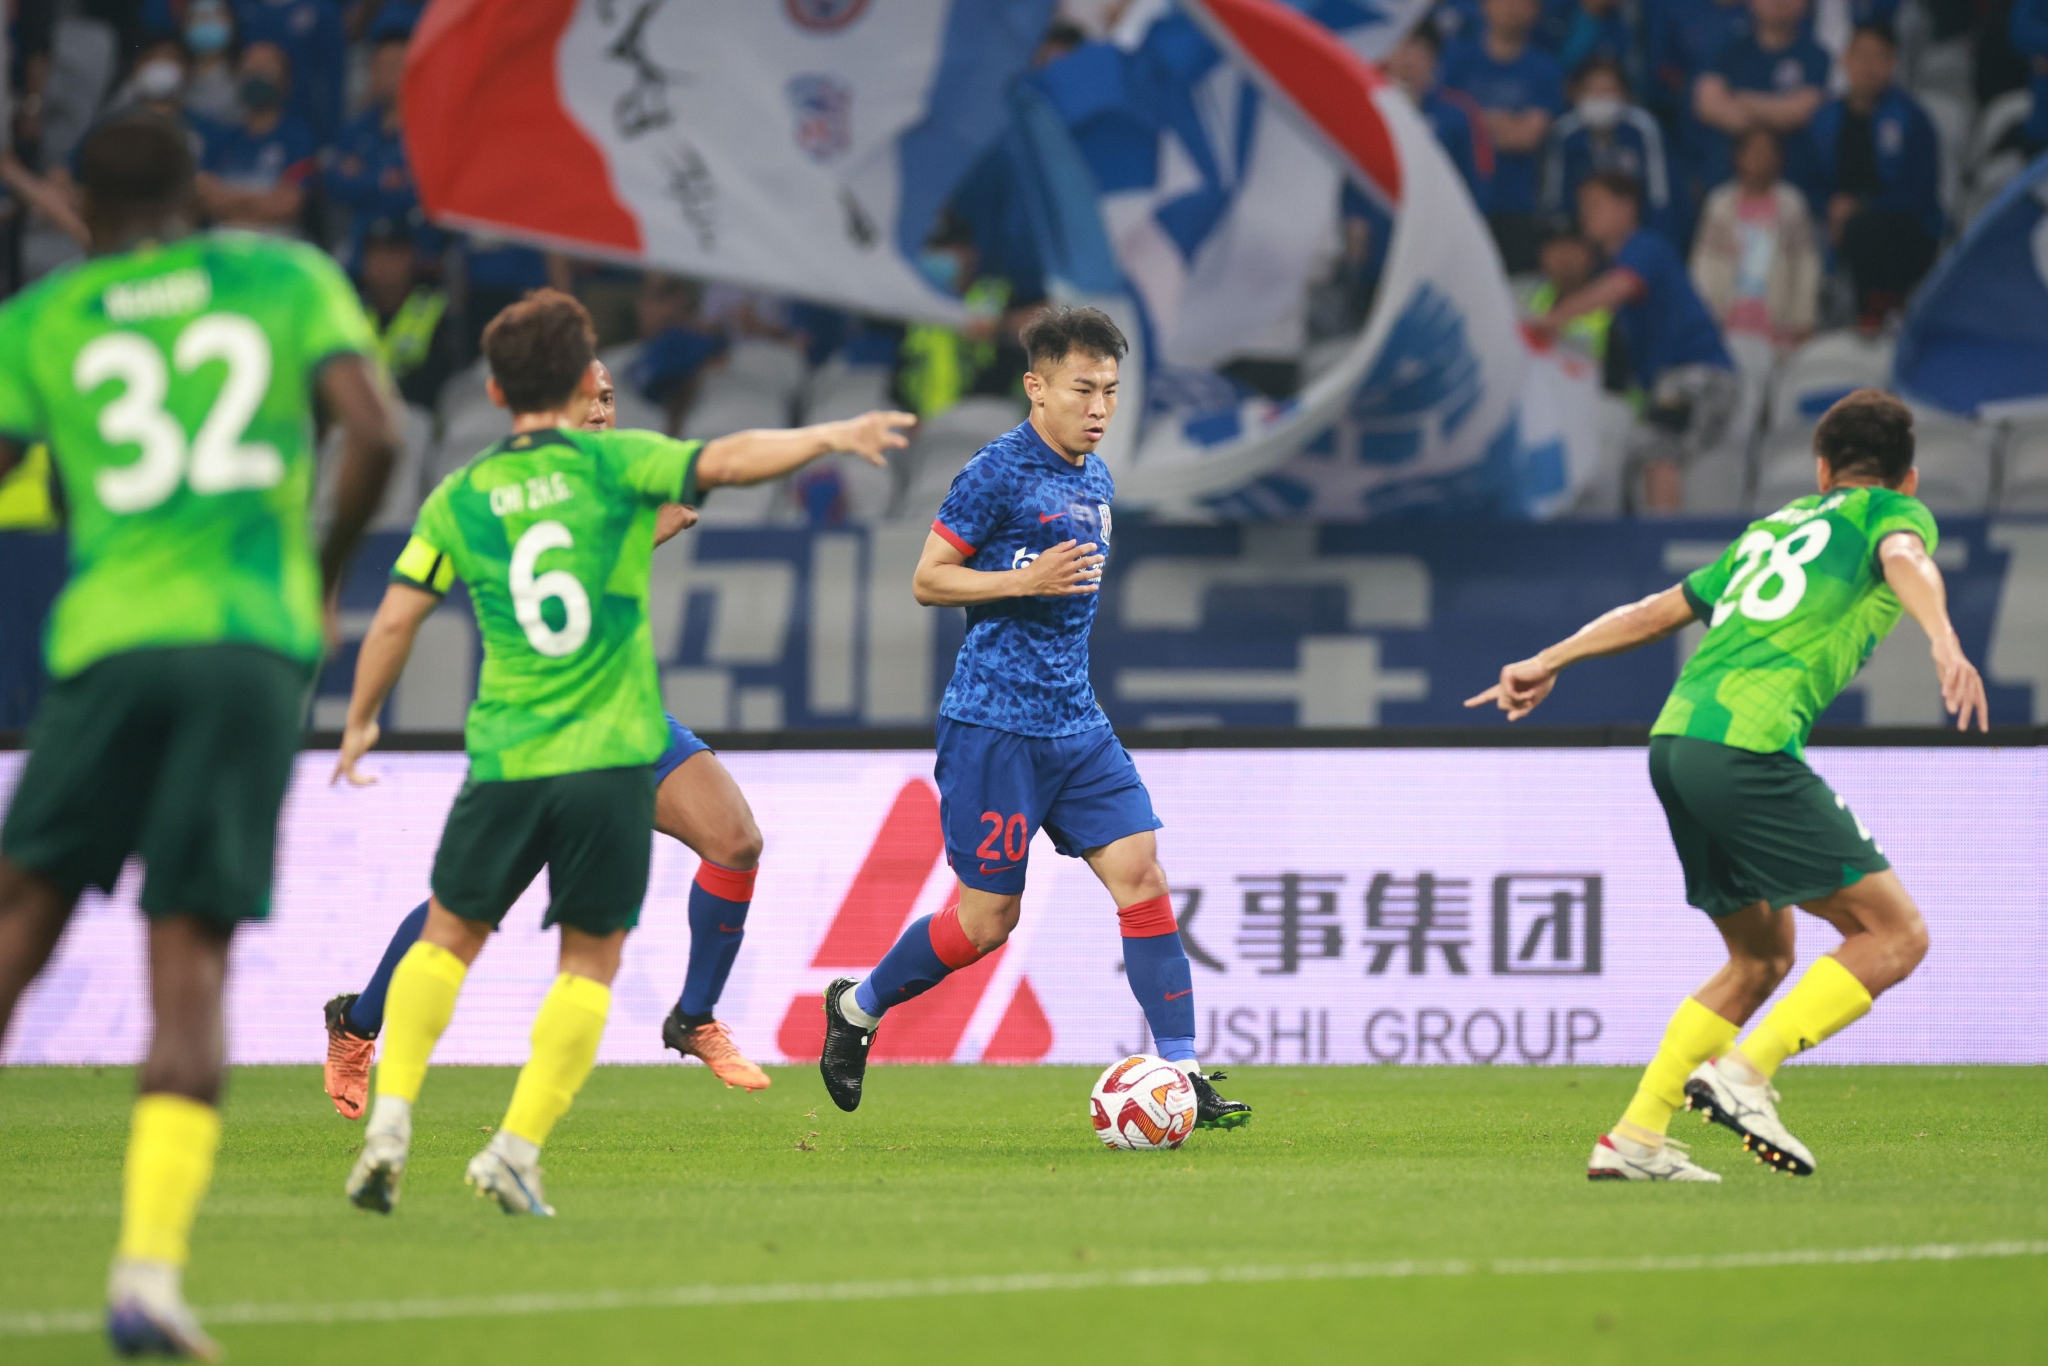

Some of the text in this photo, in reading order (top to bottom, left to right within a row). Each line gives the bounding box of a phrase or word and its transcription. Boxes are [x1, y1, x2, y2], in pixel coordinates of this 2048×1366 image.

[72, 313, 285, 514] 32
[509, 521, 592, 656] 6
[1710, 518, 1832, 628] 28
[976, 811, 1028, 862] 20
[1364, 1007, 1603, 1064] GROUP
